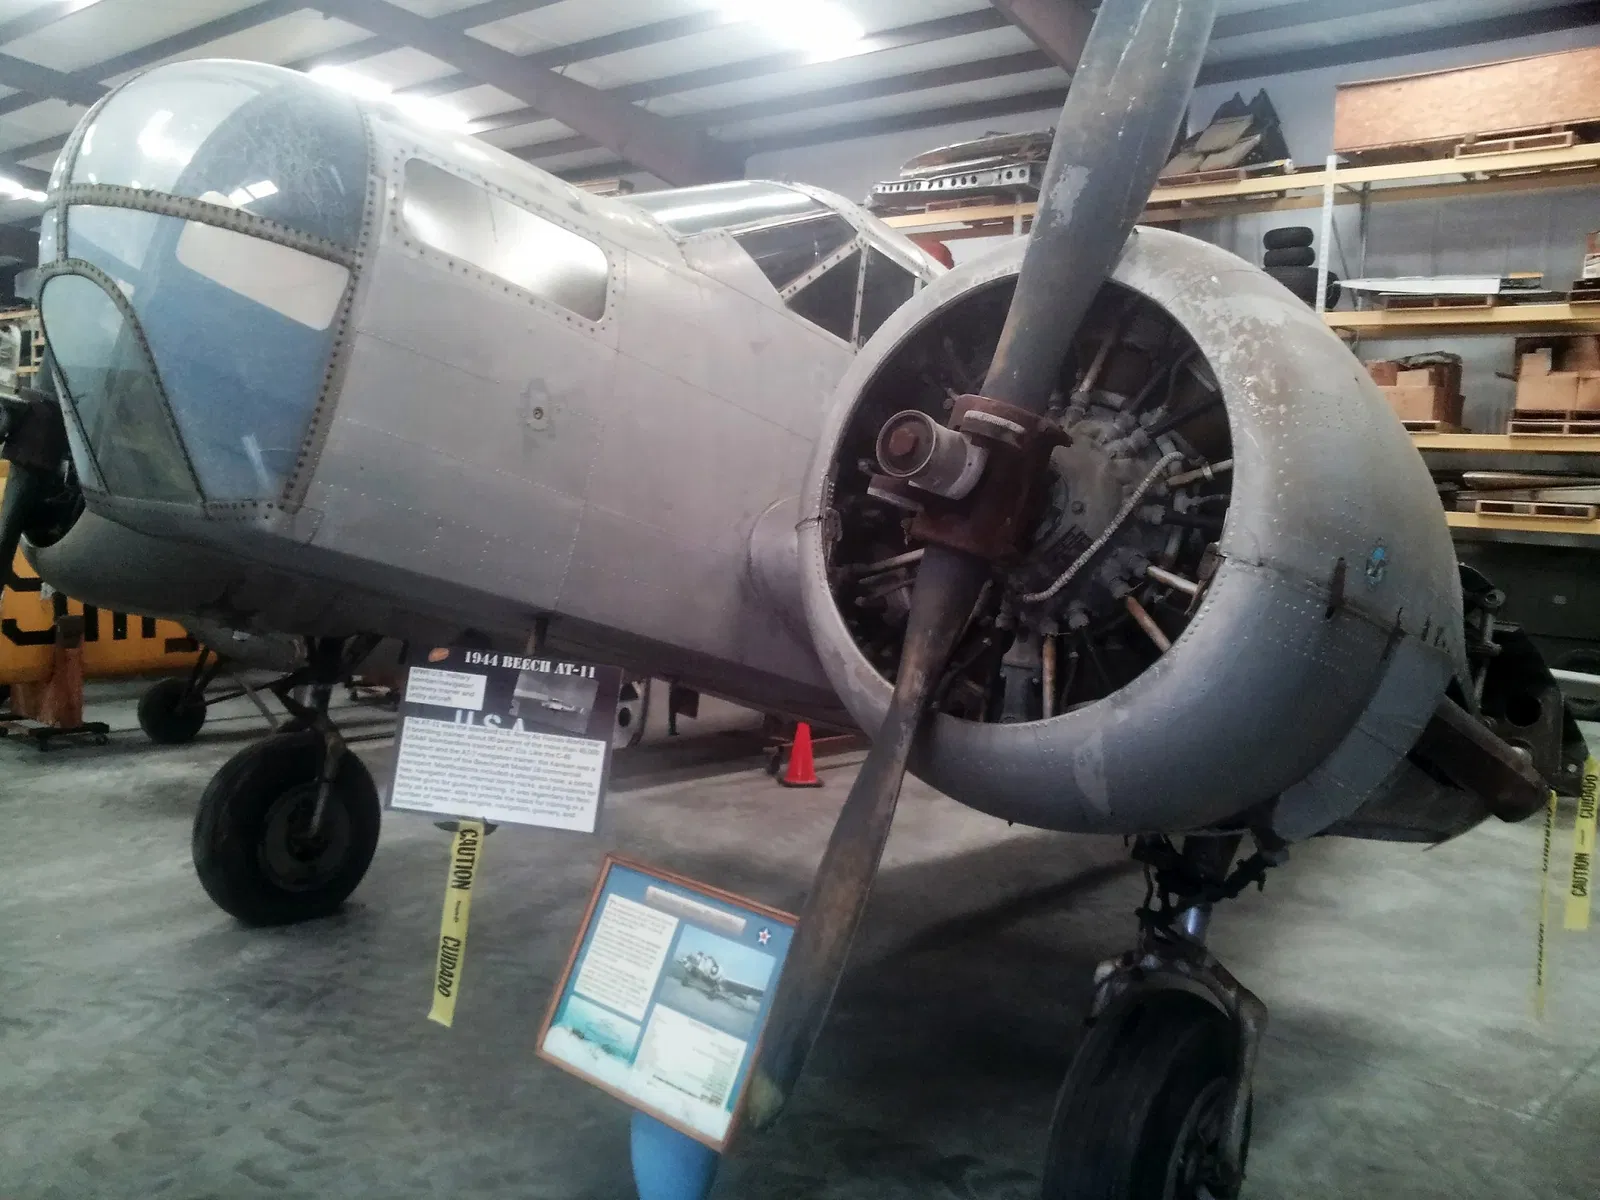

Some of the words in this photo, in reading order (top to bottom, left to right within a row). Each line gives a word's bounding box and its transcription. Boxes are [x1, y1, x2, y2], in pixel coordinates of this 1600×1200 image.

[464, 651, 499, 666] 1944
[501, 655, 552, 673] BEECH
[554, 662, 596, 679] AT-11
[1579, 774, 1598, 819] CUIDADO
[451, 828, 479, 890] CAUTION
[1571, 852, 1590, 897] CAUTION
[437, 935, 461, 998] CUIDADO
